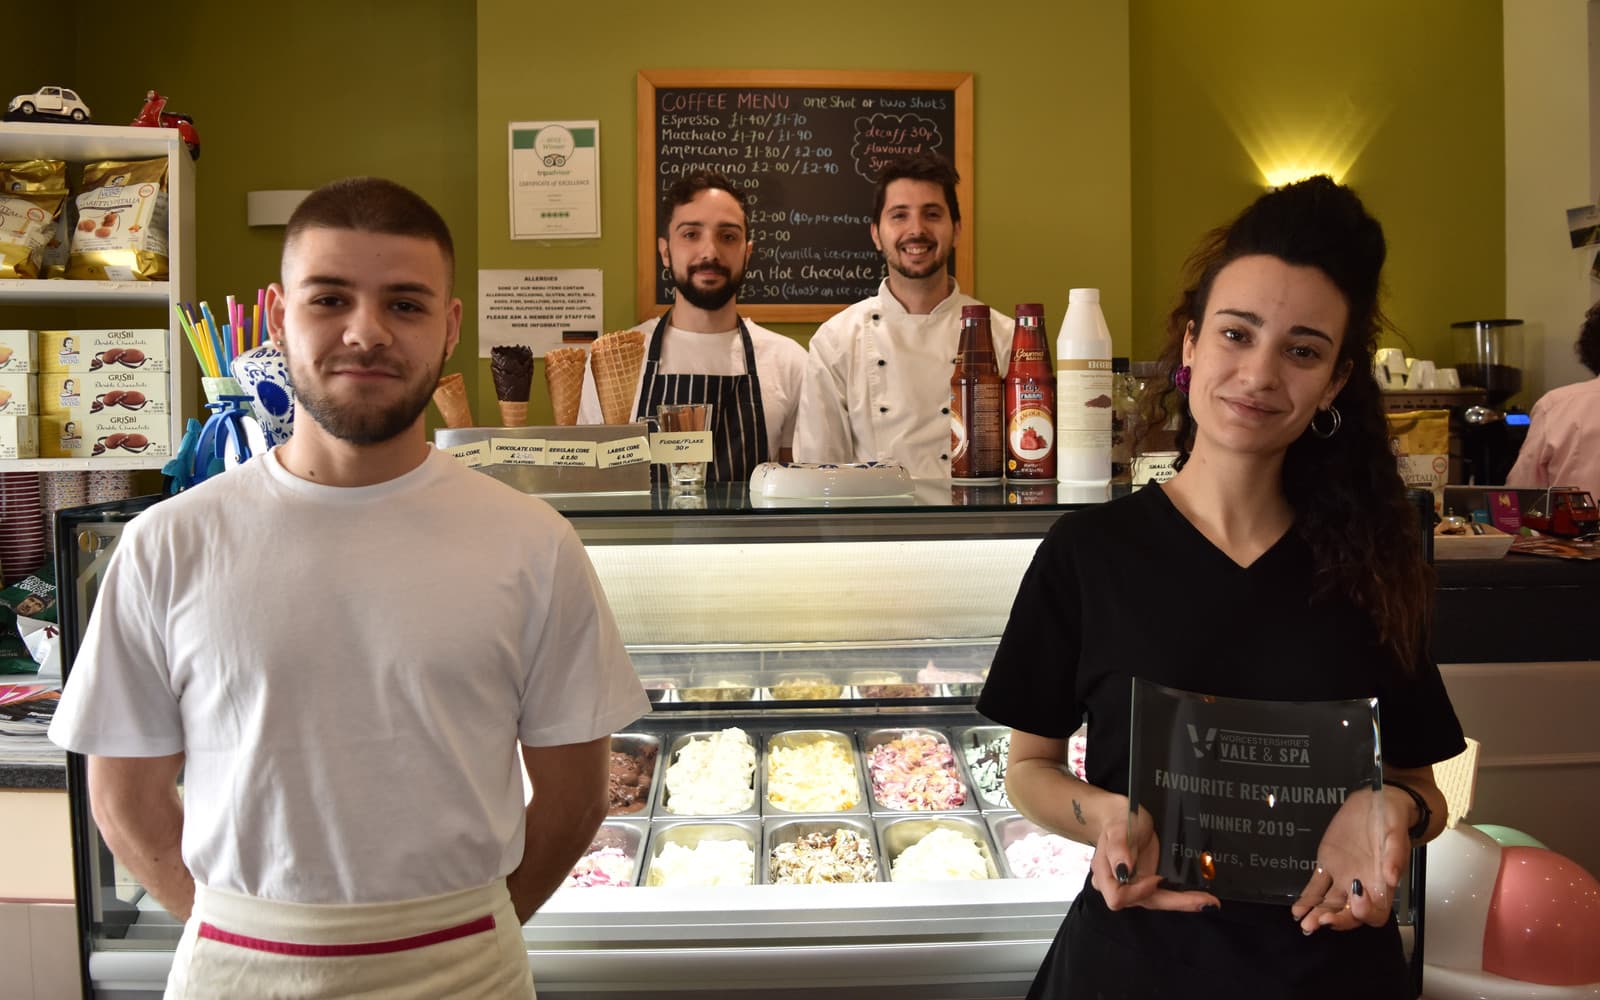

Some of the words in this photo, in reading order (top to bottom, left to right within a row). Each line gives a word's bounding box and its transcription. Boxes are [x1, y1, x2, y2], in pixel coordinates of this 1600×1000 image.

[661, 92, 728, 112] COFFEE
[737, 92, 790, 111] MENU
[661, 129, 727, 143] Macchiato
[660, 144, 738, 160] Americano
[769, 265, 793, 280] Hot
[800, 264, 874, 280] Chocolate
[1219, 733, 1311, 748] WORCESTERSHIRE'S
[1220, 743, 1257, 761] VALE
[1263, 747, 1273, 762] &
[1279, 748, 1310, 763] SPA
[1155, 769, 1234, 798] FAVOURITE
[1239, 784, 1347, 805] RESTAURANT
[1199, 813, 1252, 834] WINNER
